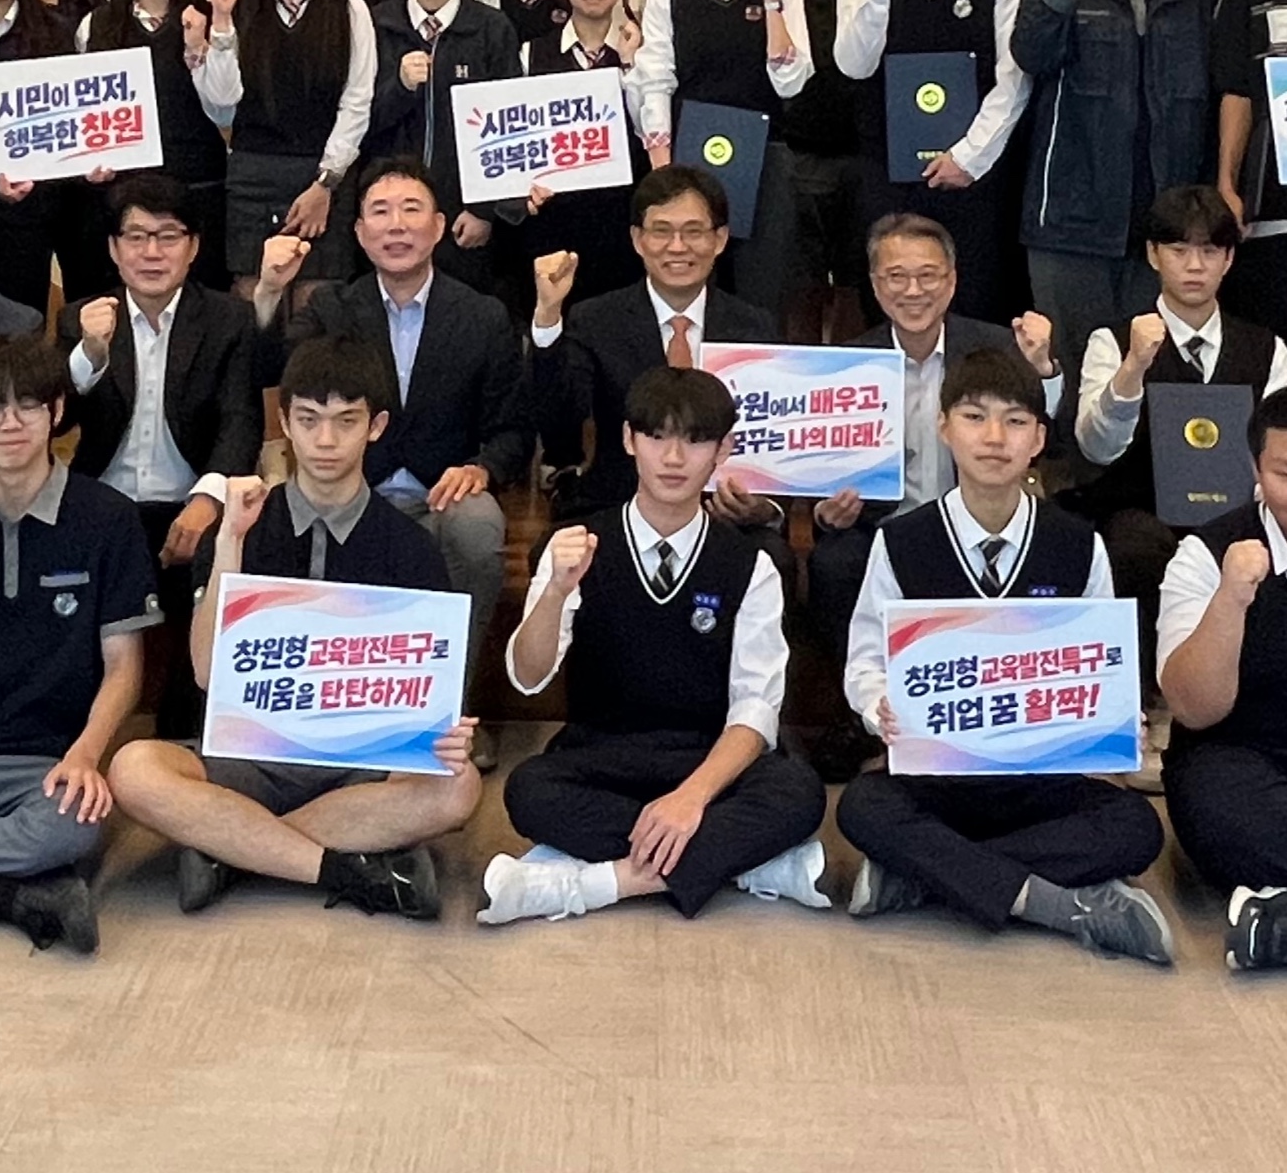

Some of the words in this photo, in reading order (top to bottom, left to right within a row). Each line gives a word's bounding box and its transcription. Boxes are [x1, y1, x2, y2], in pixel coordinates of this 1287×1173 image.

[74, 71, 136, 108] 먼저,
[3, 118, 79, 160] 행복한
[81, 104, 144, 149] 창원
[480, 103, 545, 139] 시민이
[548, 95, 601, 127] 먼저,
[480, 138, 549, 179] 행복한
[551, 125, 611, 167] 창원
[809, 384, 888, 415] 배우고,
[788, 425, 827, 451] 나의
[830, 419, 884, 449] 미래!
[242, 676, 316, 713] 배움을
[319, 675, 434, 710] 탄탄하게!
[926, 696, 984, 735] 취업
[989, 691, 1019, 727] 꿈
[1024, 682, 1101, 725] 활짝!
